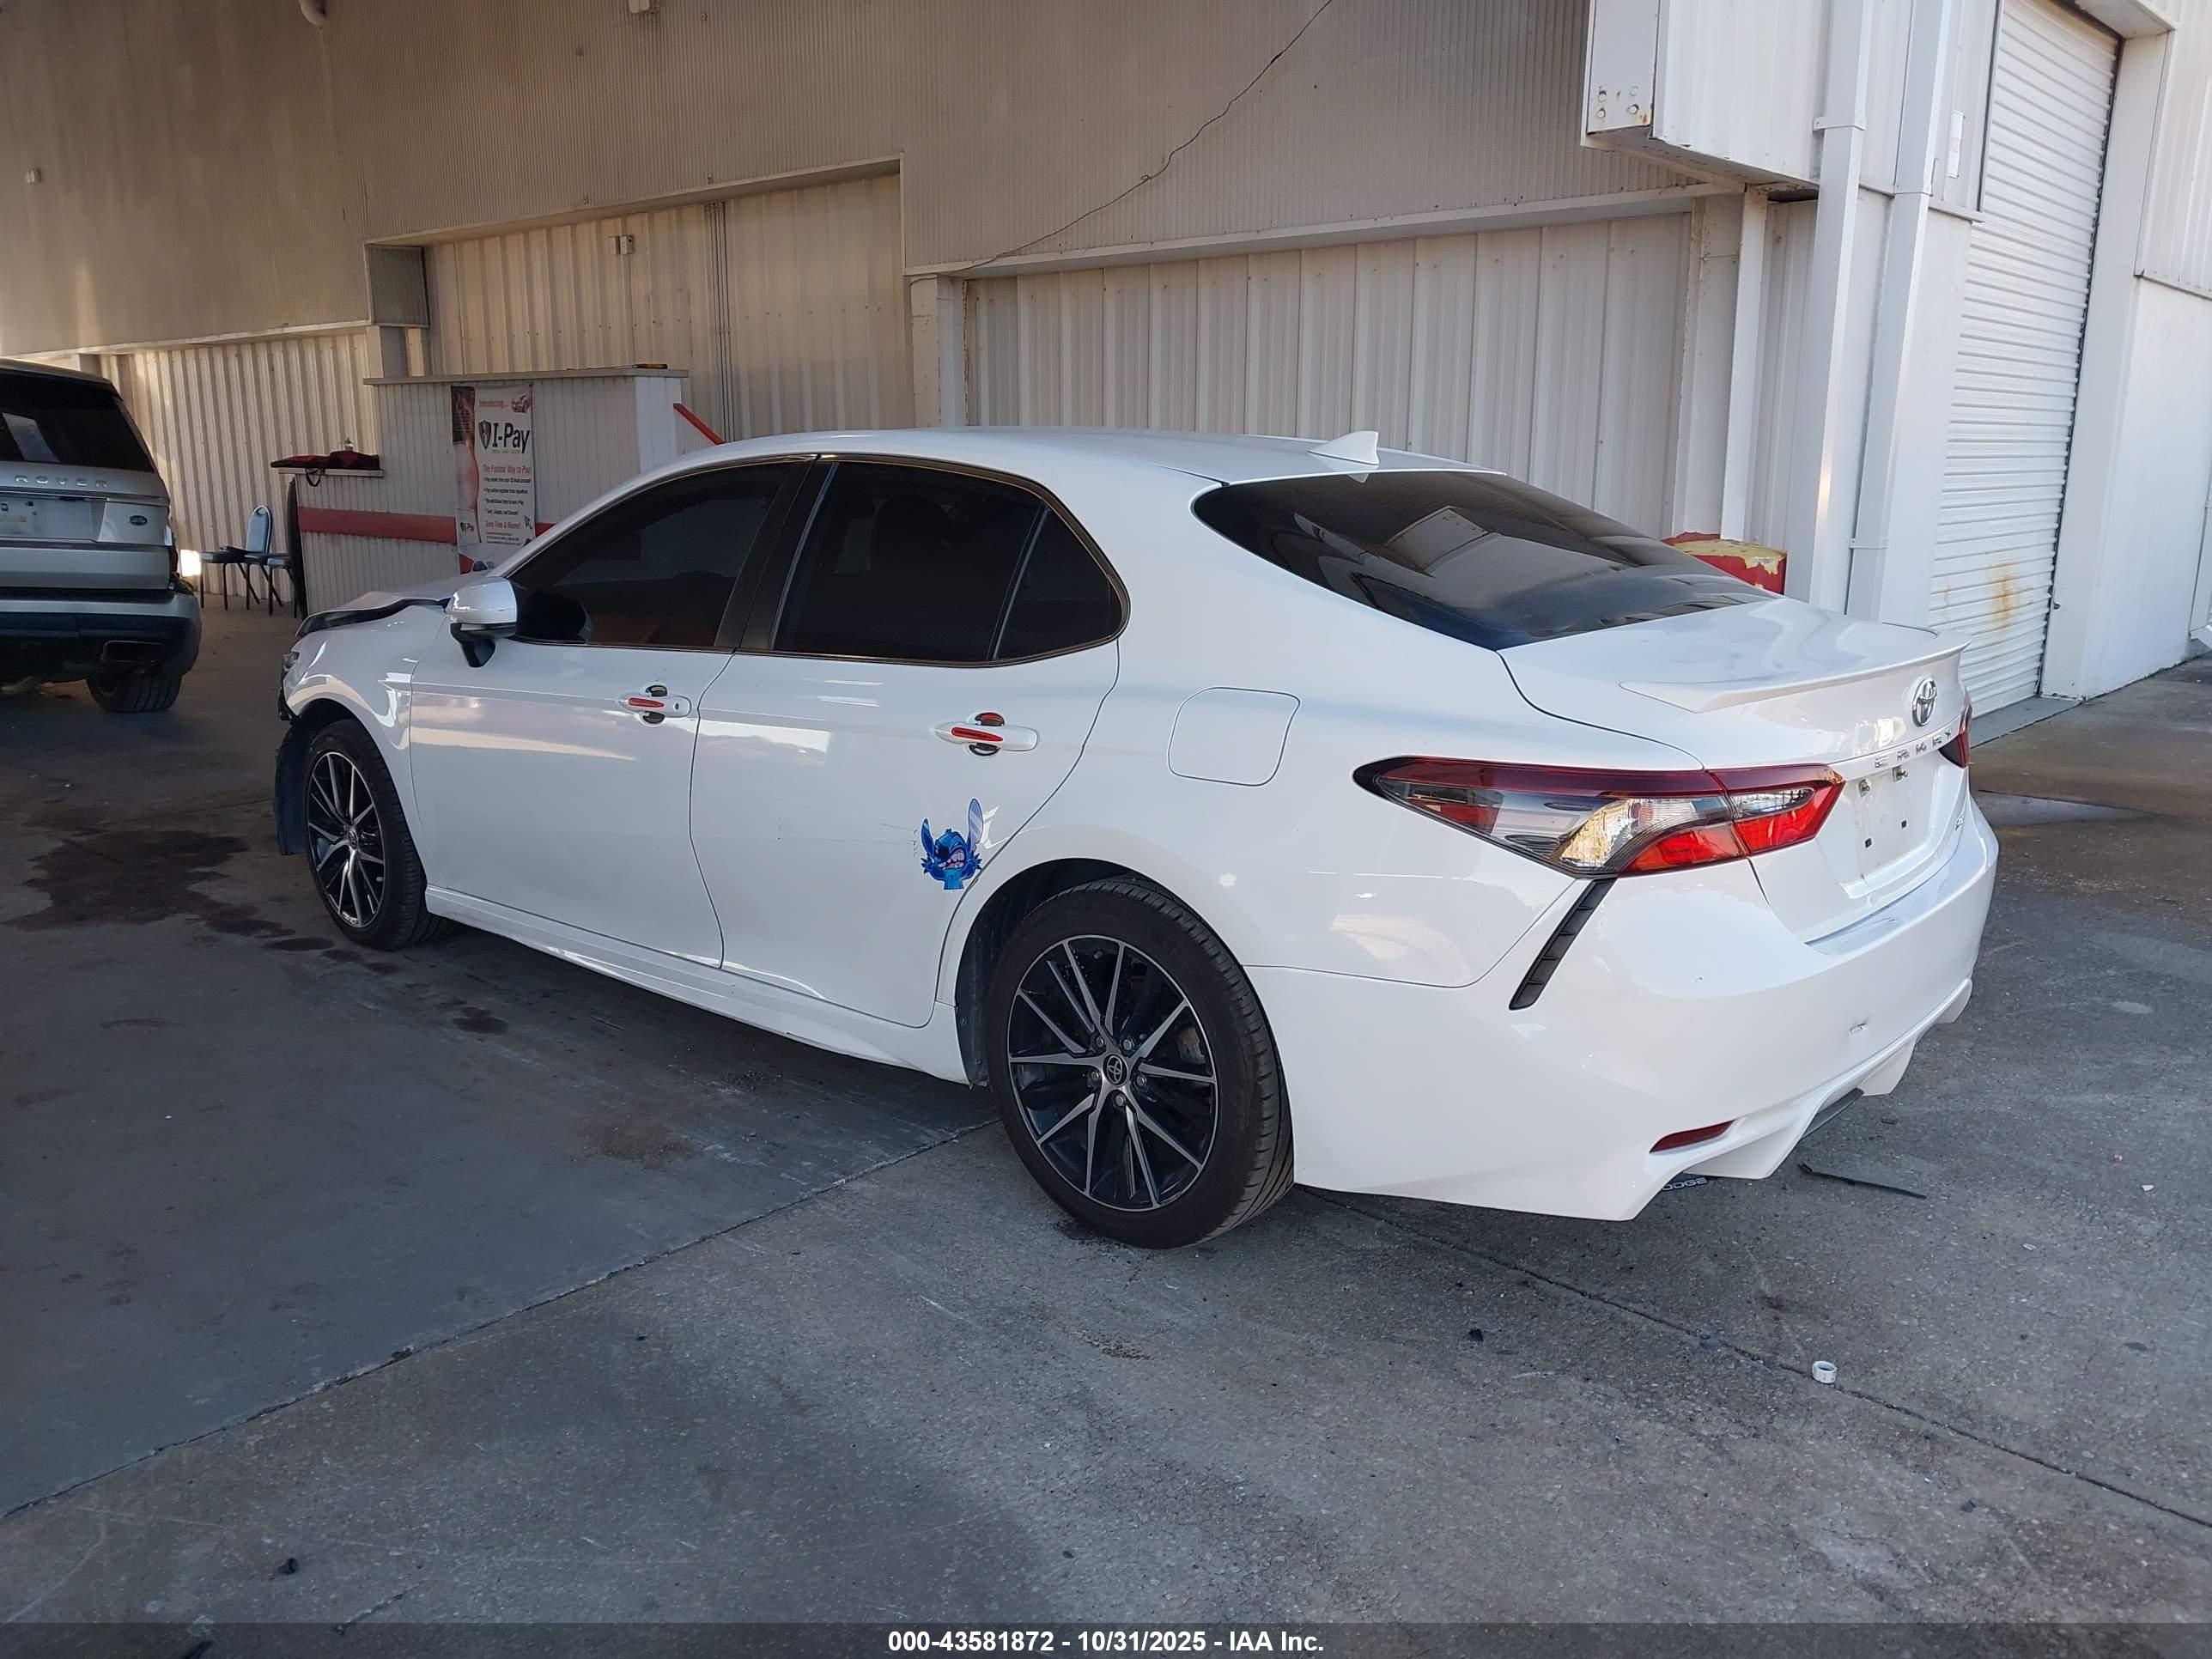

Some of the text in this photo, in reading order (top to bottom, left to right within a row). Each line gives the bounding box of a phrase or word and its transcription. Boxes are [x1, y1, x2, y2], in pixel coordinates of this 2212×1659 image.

[492, 422, 530, 453] I-Pay
[15, 475, 107, 489] ROVER
[1662, 1176, 1708, 1191] ODGE
